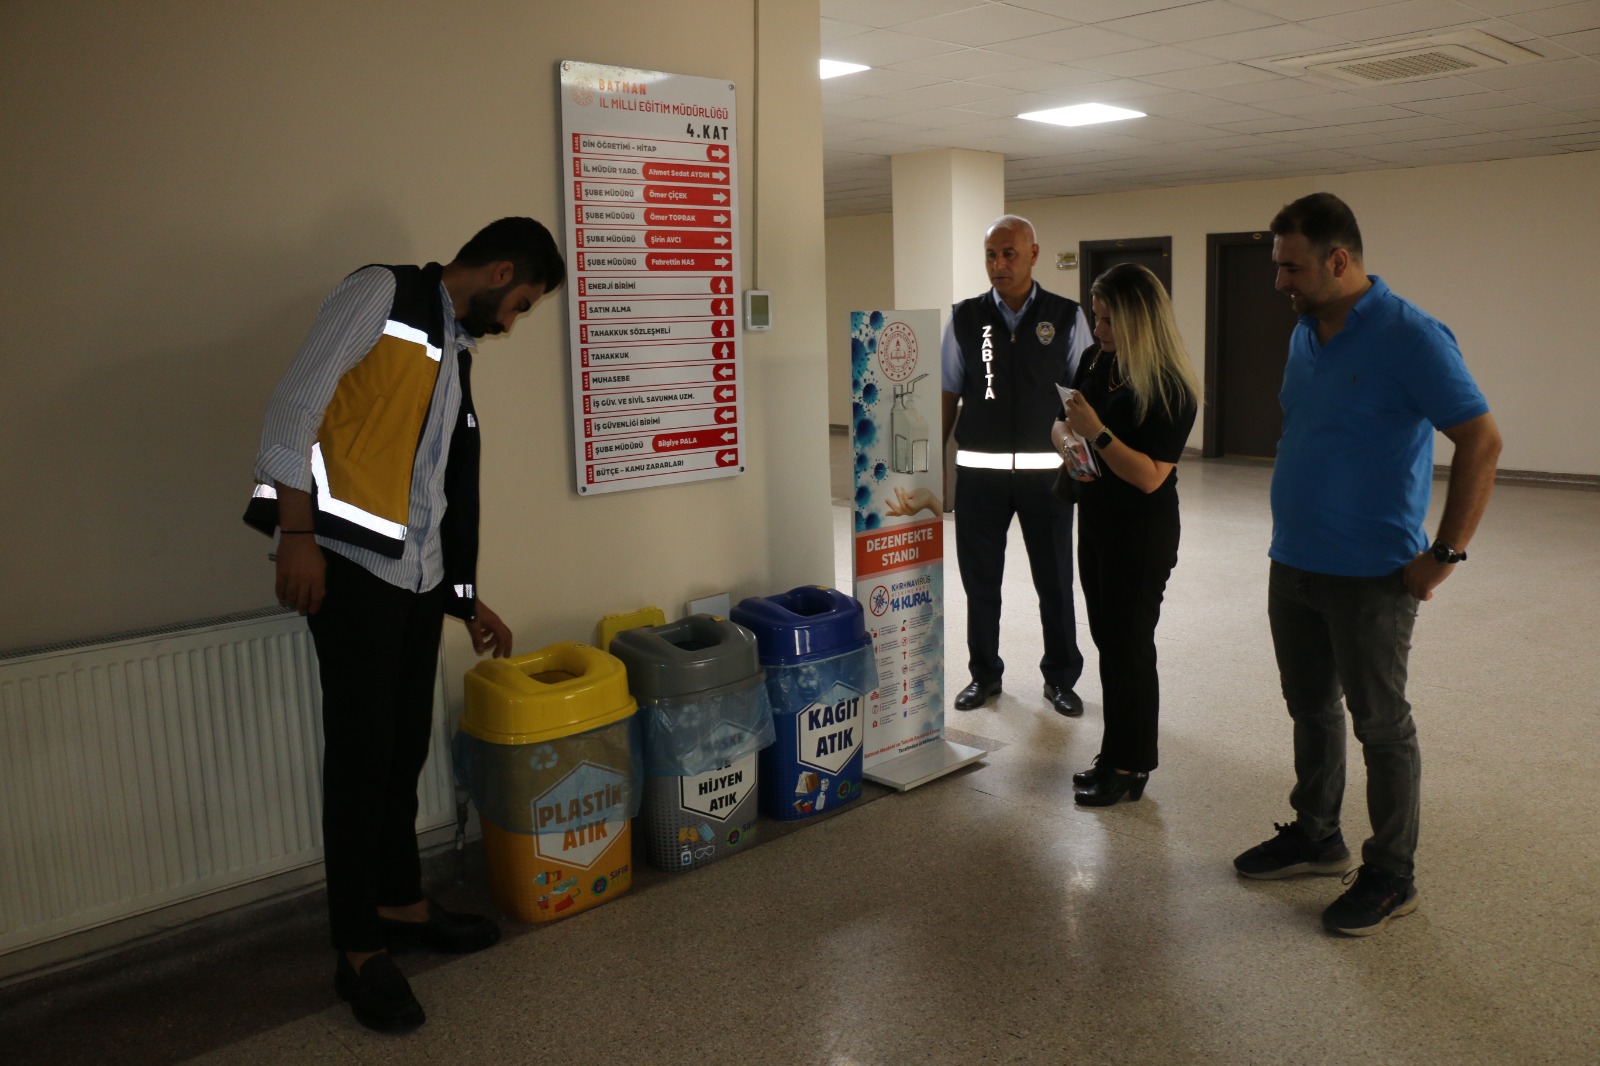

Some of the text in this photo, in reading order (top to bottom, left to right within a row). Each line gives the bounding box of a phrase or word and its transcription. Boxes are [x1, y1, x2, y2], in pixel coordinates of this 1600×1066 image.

[598, 79, 647, 95] BATMAN
[600, 97, 728, 119] İL MİLLİ EĞİTİM MÜDÜRLÜĞÜ
[597, 140, 631, 151] ÖĞRETİMİ
[583, 164, 590, 172] İL
[591, 165, 617, 174] MÜDÜR
[584, 188, 634, 197] ŞUBE MÜDÜRÜ
[668, 192, 687, 200] ÇİÇEK
[585, 212, 635, 220] ŞUBE MÜDÜRÜ
[586, 235, 604, 243] ŞUBE
[587, 258, 636, 267] ŞUBE MÜDÜRÜ
[588, 281, 636, 290] ENERJİ BİRİMİ
[589, 306, 610, 314] SATIN
[630, 326, 671, 336] SÖZLEŞMELİ
[591, 352, 629, 360] TAHAKKUK
[982, 326, 996, 400] ZABITA
[592, 375, 630, 383] MUHASEBE
[593, 399, 600, 408] İŞ
[601, 398, 617, 407] GÜV.
[628, 396, 645, 404] SİVİL
[646, 395, 678, 403] SAVUNMA
[594, 416, 661, 431] İŞ GÜVENLİĞİ BİRİMİ
[595, 442, 644, 454] ŞUBE MÜDÜRÜ
[596, 466, 620, 477] BÜTÇE
[625, 464, 645, 473] KAMU
[646, 460, 684, 470] ZARARLARI
[866, 528, 934, 552] DEZENFEKTE
[881, 546, 919, 566] STANDI
[890, 590, 932, 612] 14 KURAL
[808, 697, 859, 731] KAĞIT
[816, 727, 853, 758] ATIK
[698, 770, 743, 796] HİJYEN
[538, 783, 624, 828] PLASTİK
[709, 791, 737, 812] ATIK
[563, 818, 608, 851] ATIK
[610, 864, 629, 880] SIFIR
